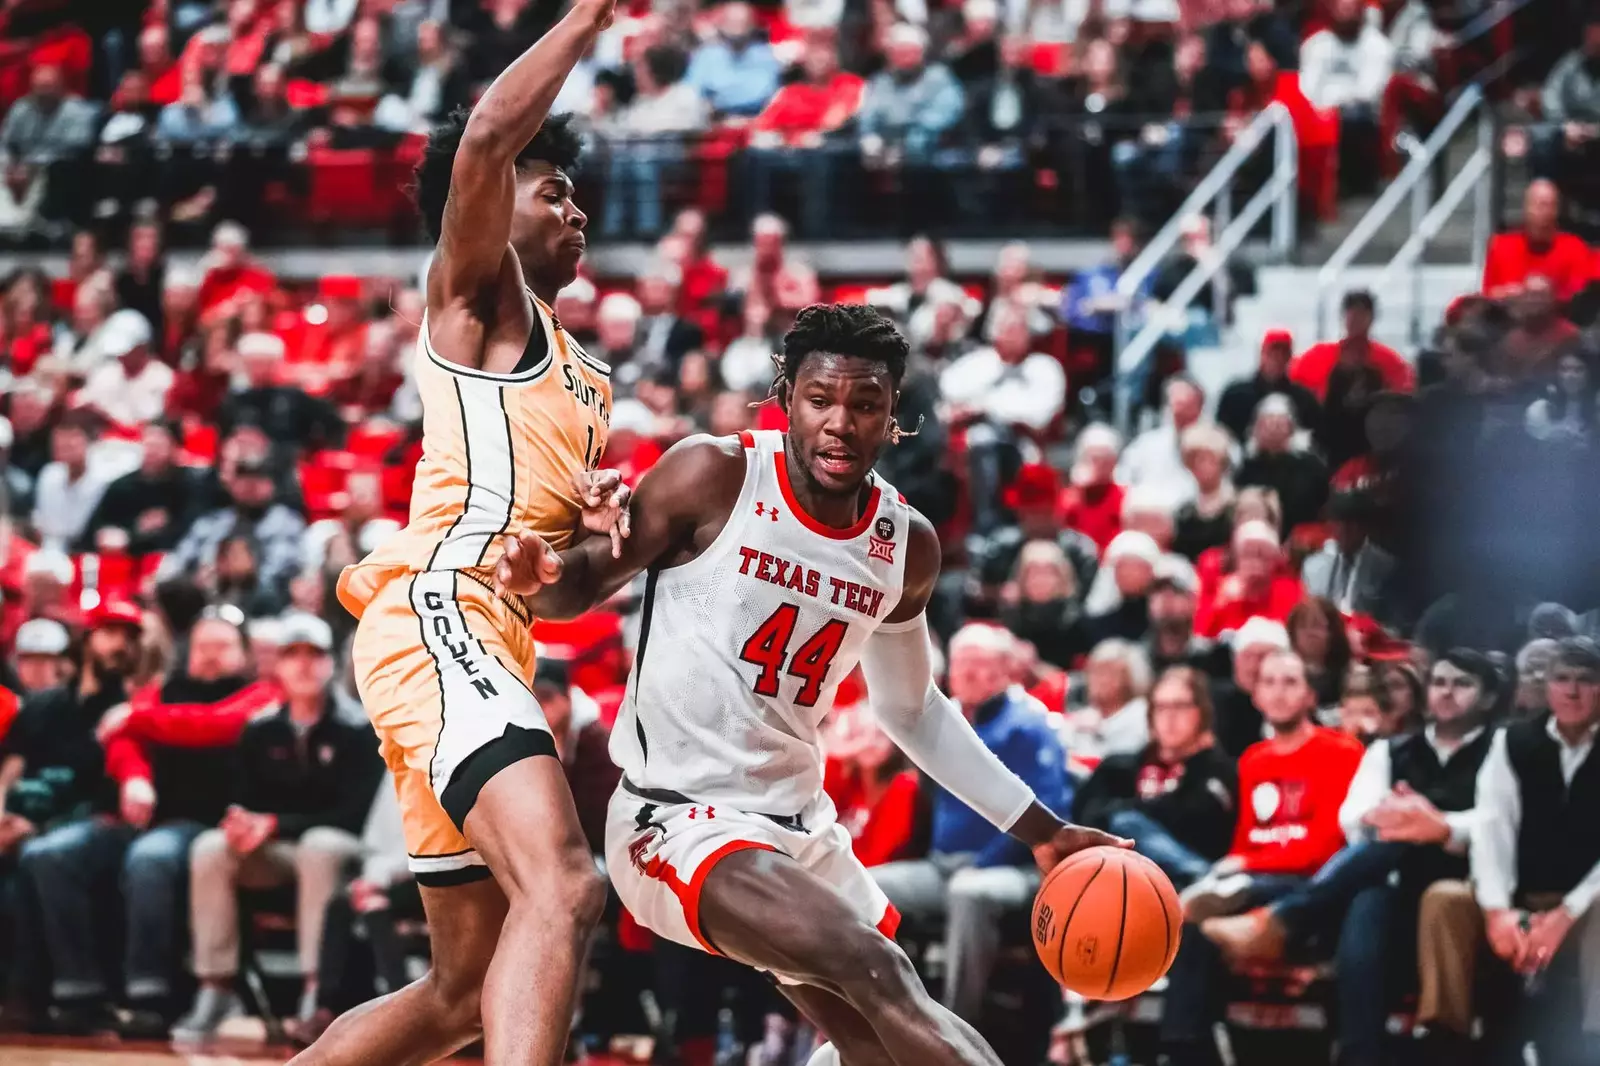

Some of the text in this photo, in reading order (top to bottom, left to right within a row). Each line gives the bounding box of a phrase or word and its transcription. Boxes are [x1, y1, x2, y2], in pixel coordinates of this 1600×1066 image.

[738, 546, 885, 618] TEXAS TECH
[738, 601, 849, 708] 44
